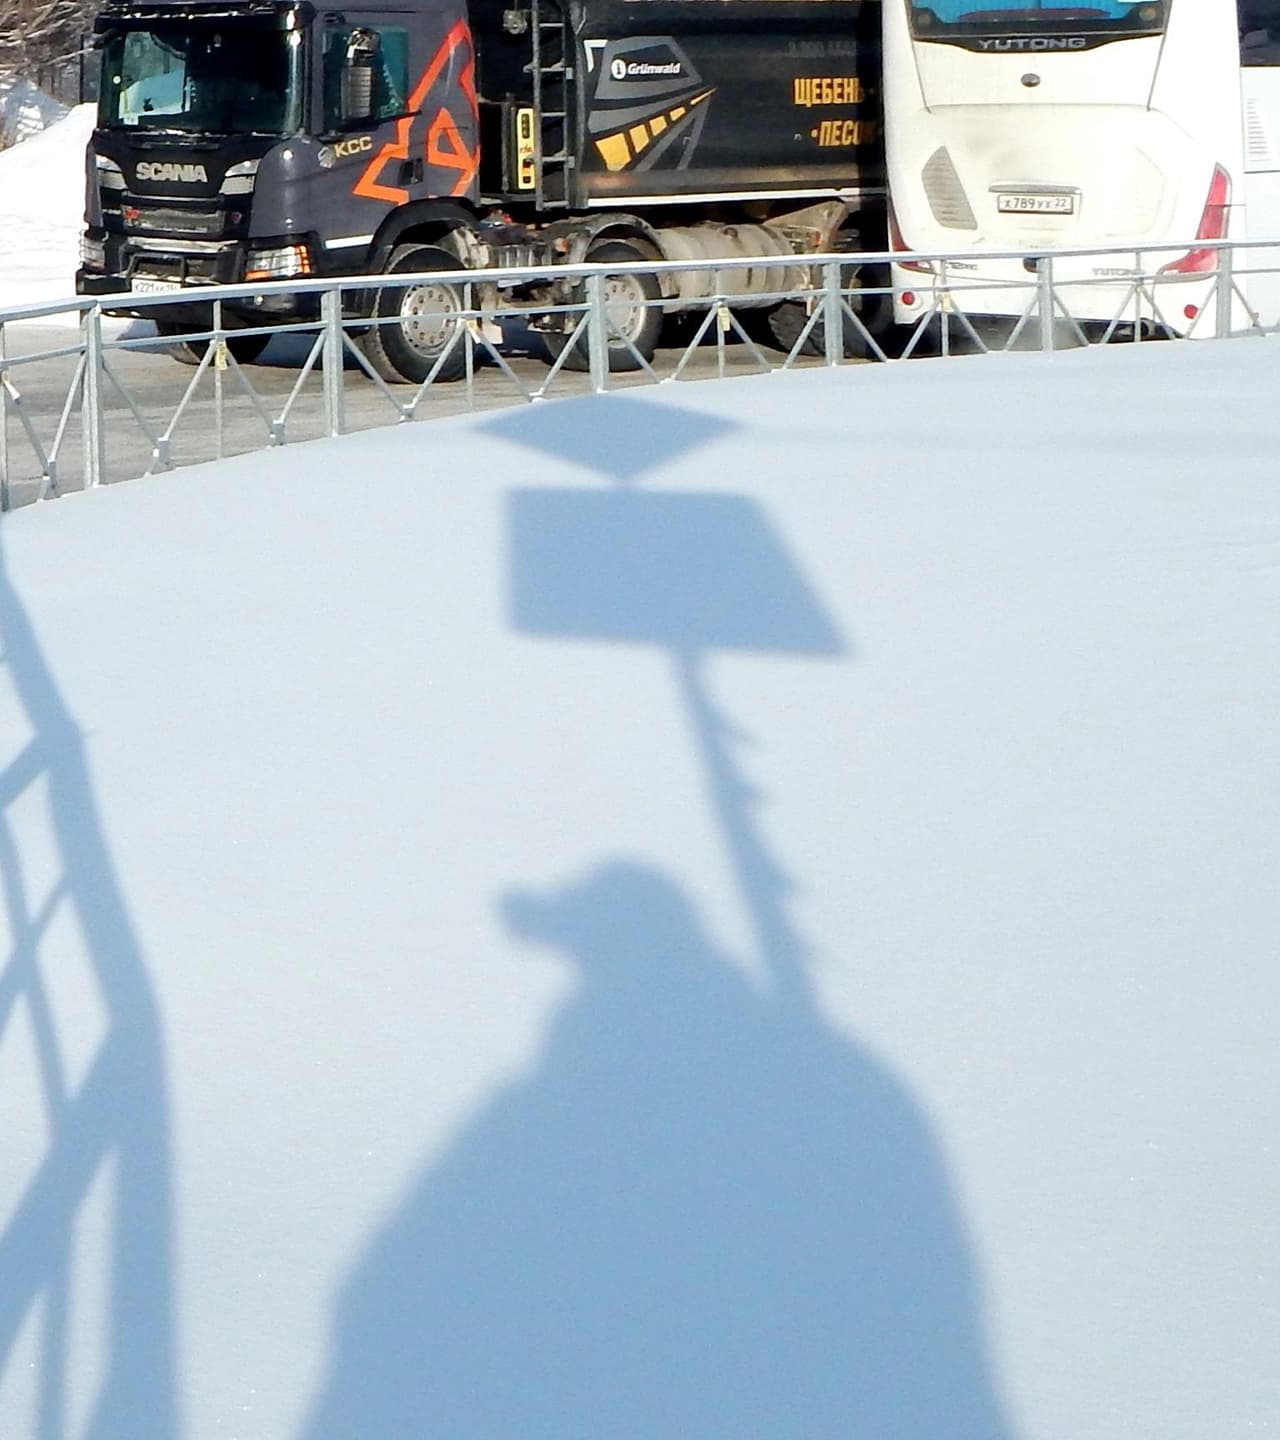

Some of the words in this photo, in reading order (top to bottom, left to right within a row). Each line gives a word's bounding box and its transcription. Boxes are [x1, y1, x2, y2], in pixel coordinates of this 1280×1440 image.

[979, 37, 1087, 50] YUTONG
[135, 162, 208, 184] SCANIA
[1092, 267, 1146, 277] YUTON
